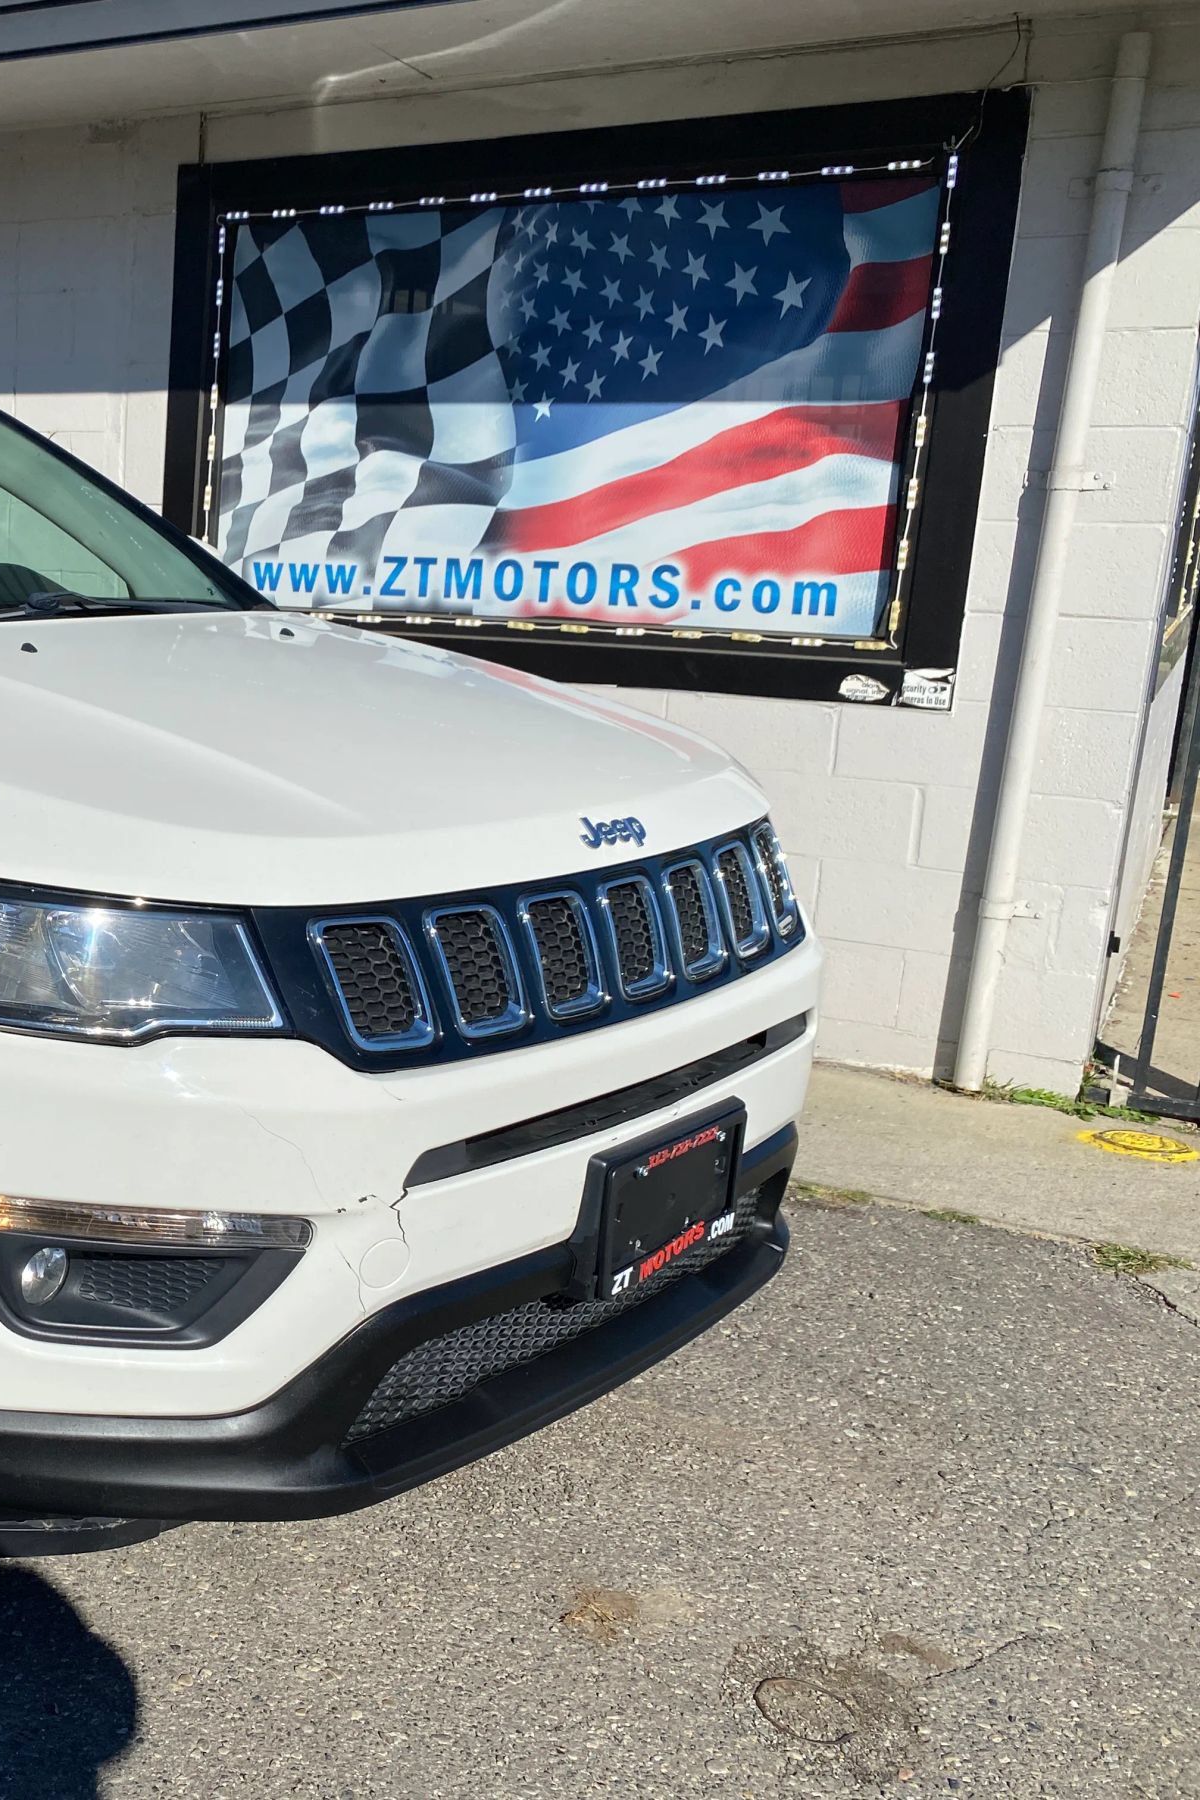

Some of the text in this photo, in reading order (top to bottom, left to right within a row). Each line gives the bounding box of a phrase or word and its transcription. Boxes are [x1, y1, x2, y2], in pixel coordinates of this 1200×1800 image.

[252, 555, 838, 617] www.ZTMOTORS.com
[934, 696, 947, 706] Use
[579, 816, 646, 849] Jeep
[611, 1212, 736, 1296] ZT MOTORS .COM
